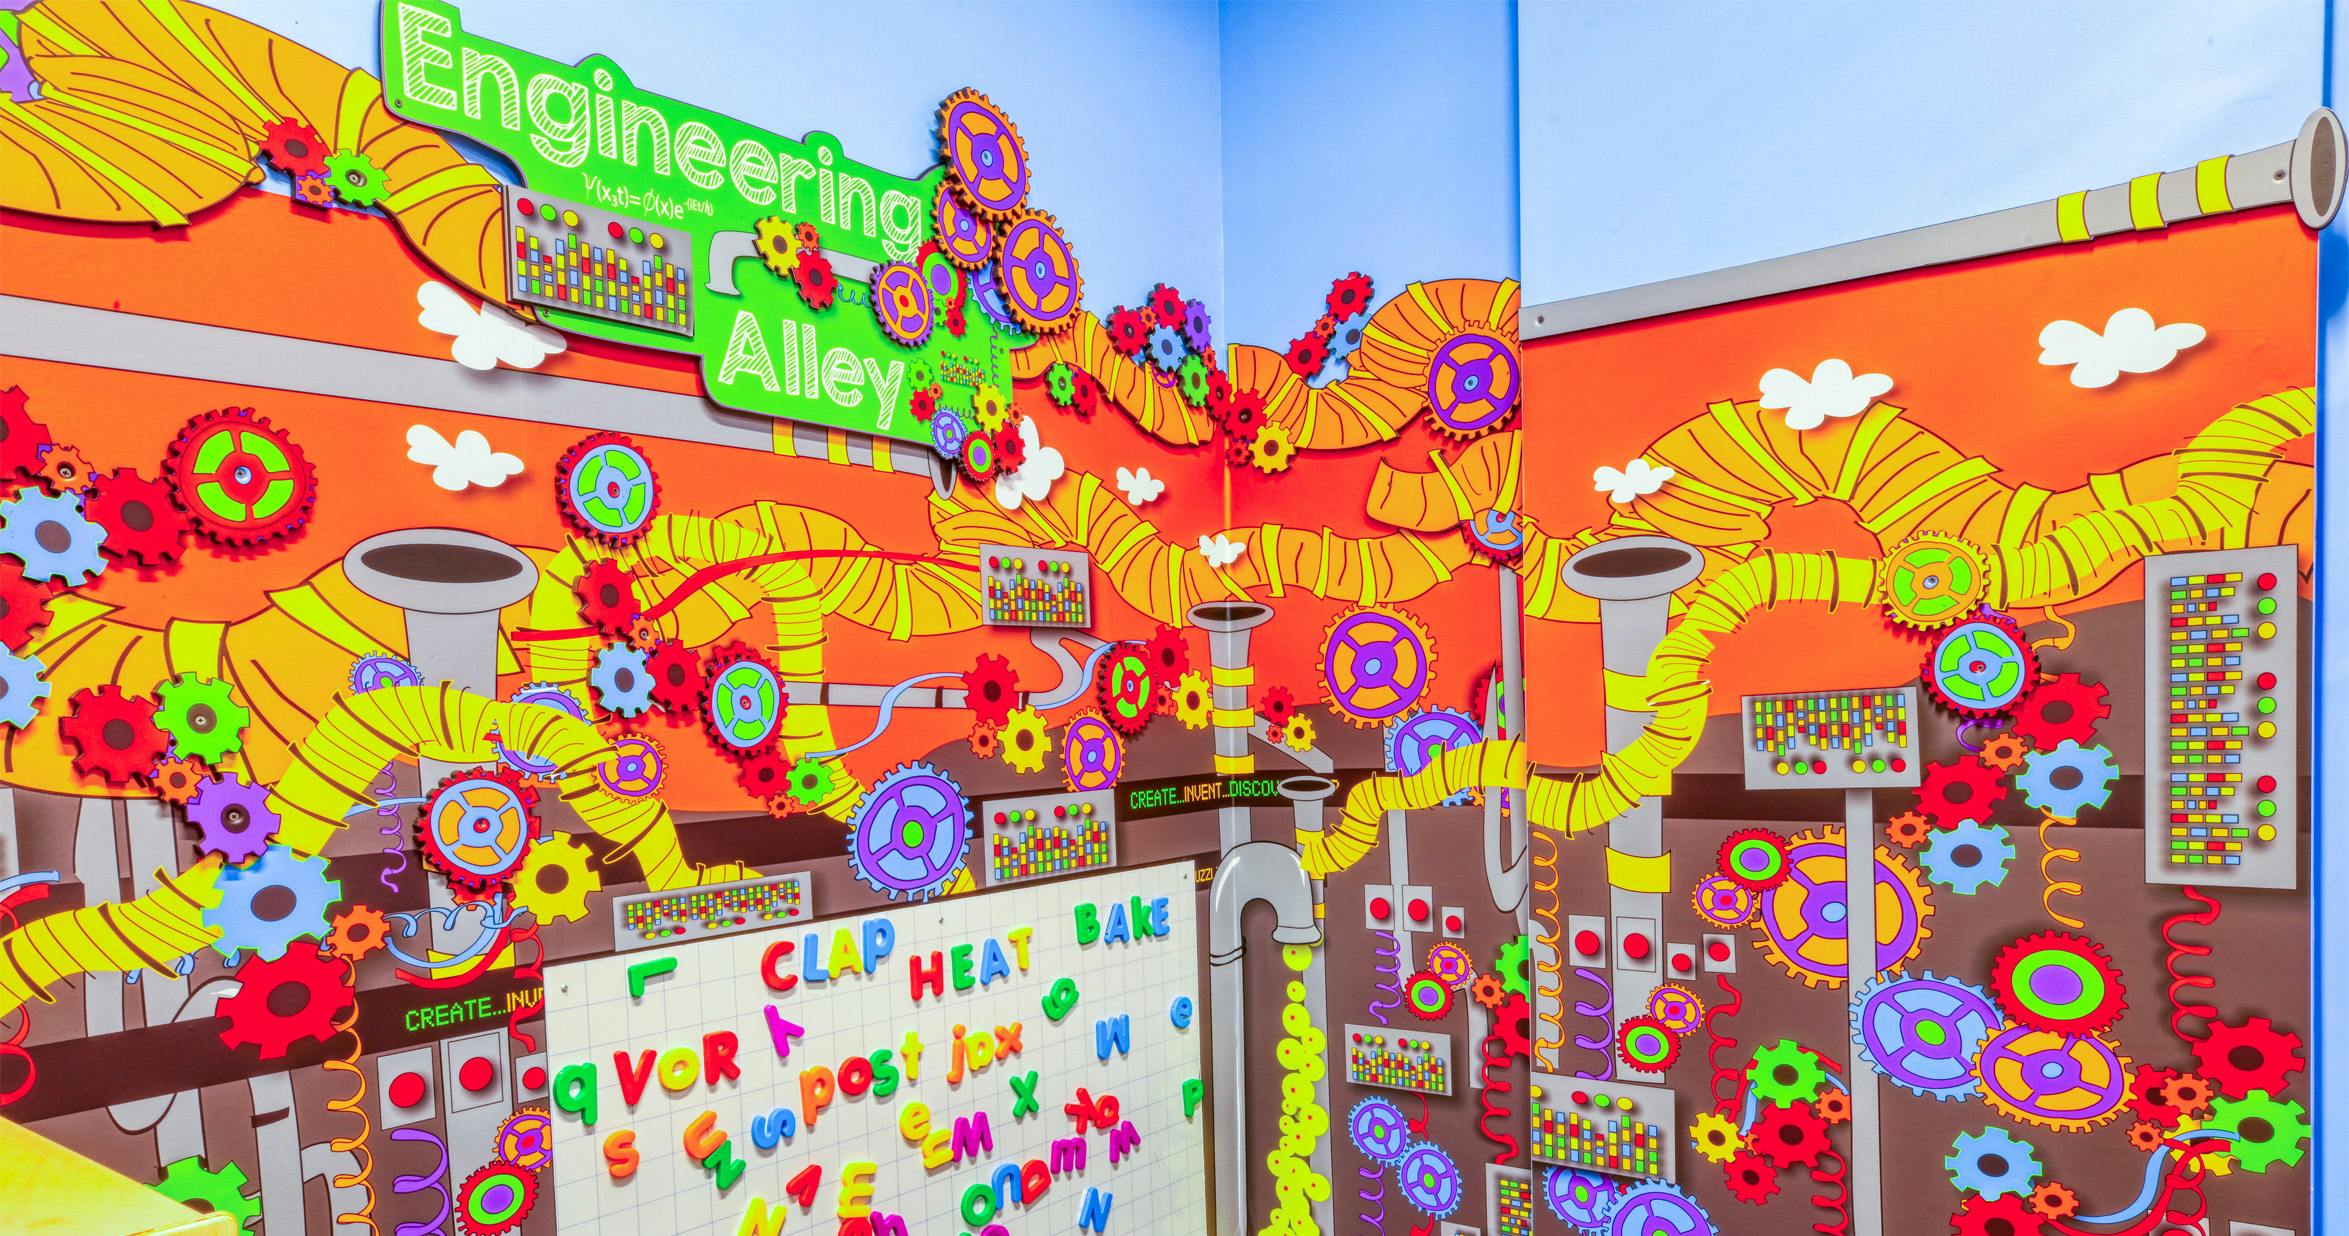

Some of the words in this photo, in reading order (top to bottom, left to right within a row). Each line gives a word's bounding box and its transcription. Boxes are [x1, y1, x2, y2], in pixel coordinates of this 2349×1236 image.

[396, 2, 922, 262] Engineering
[718, 310, 904, 431] Alley
[761, 918, 895, 991] CLAP
[909, 926, 1033, 1001] HEAT
[1170, 995, 1193, 1029] e
